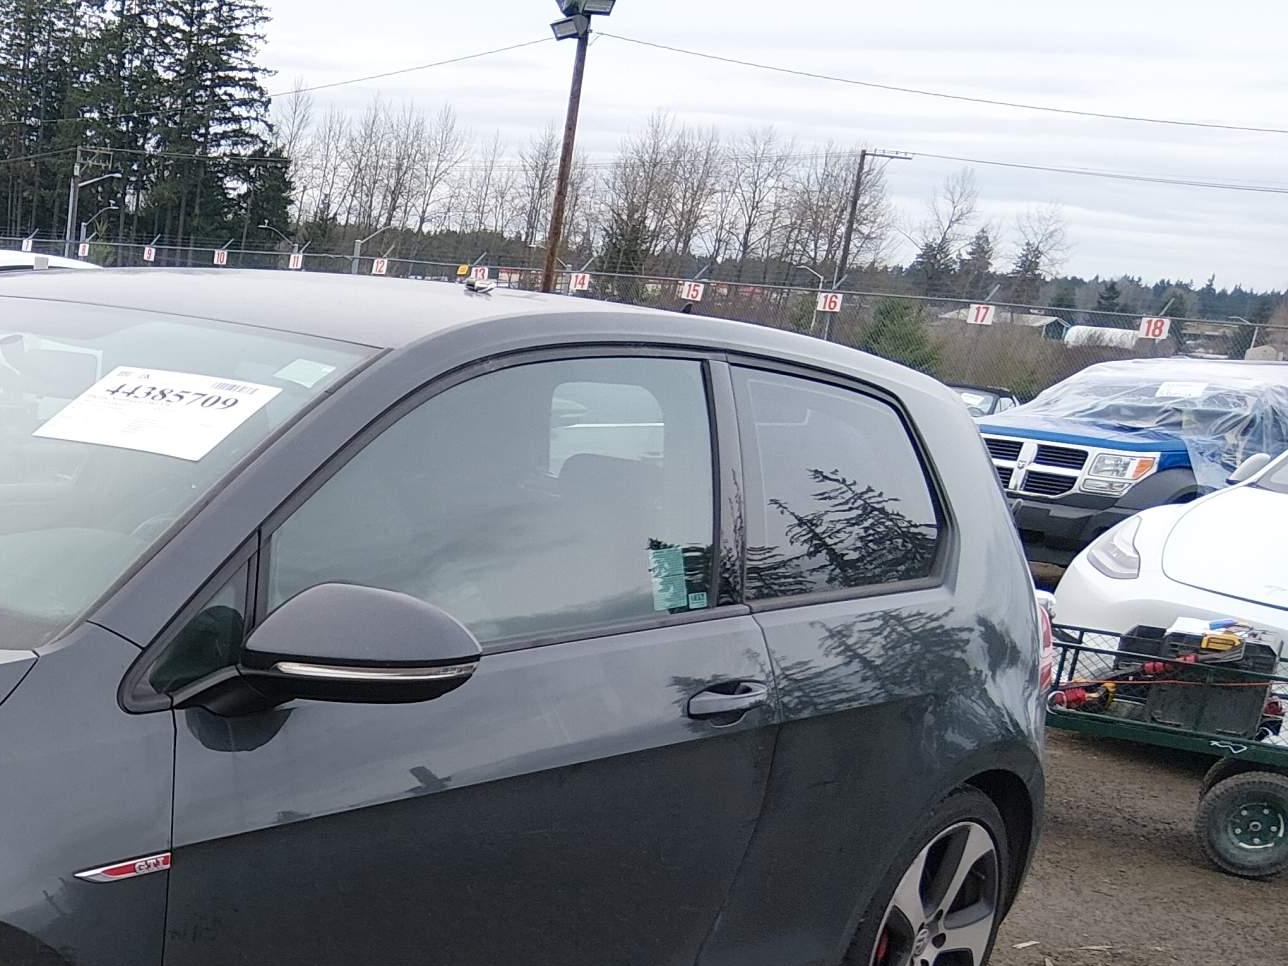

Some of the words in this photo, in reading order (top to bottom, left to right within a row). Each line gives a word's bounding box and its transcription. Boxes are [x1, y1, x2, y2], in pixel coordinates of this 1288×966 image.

[146, 247, 154, 260] 9
[216, 252, 227, 263] 10
[291, 255, 301, 267] 11
[374, 260, 386, 273] 12
[474, 268, 486, 279] 13
[574, 275, 587, 289] 14
[685, 284, 700, 299] 15
[822, 294, 837, 310] 16
[974, 306, 990, 323] 17
[1144, 319, 1165, 337] 18
[106, 383, 239, 410] 44385709
